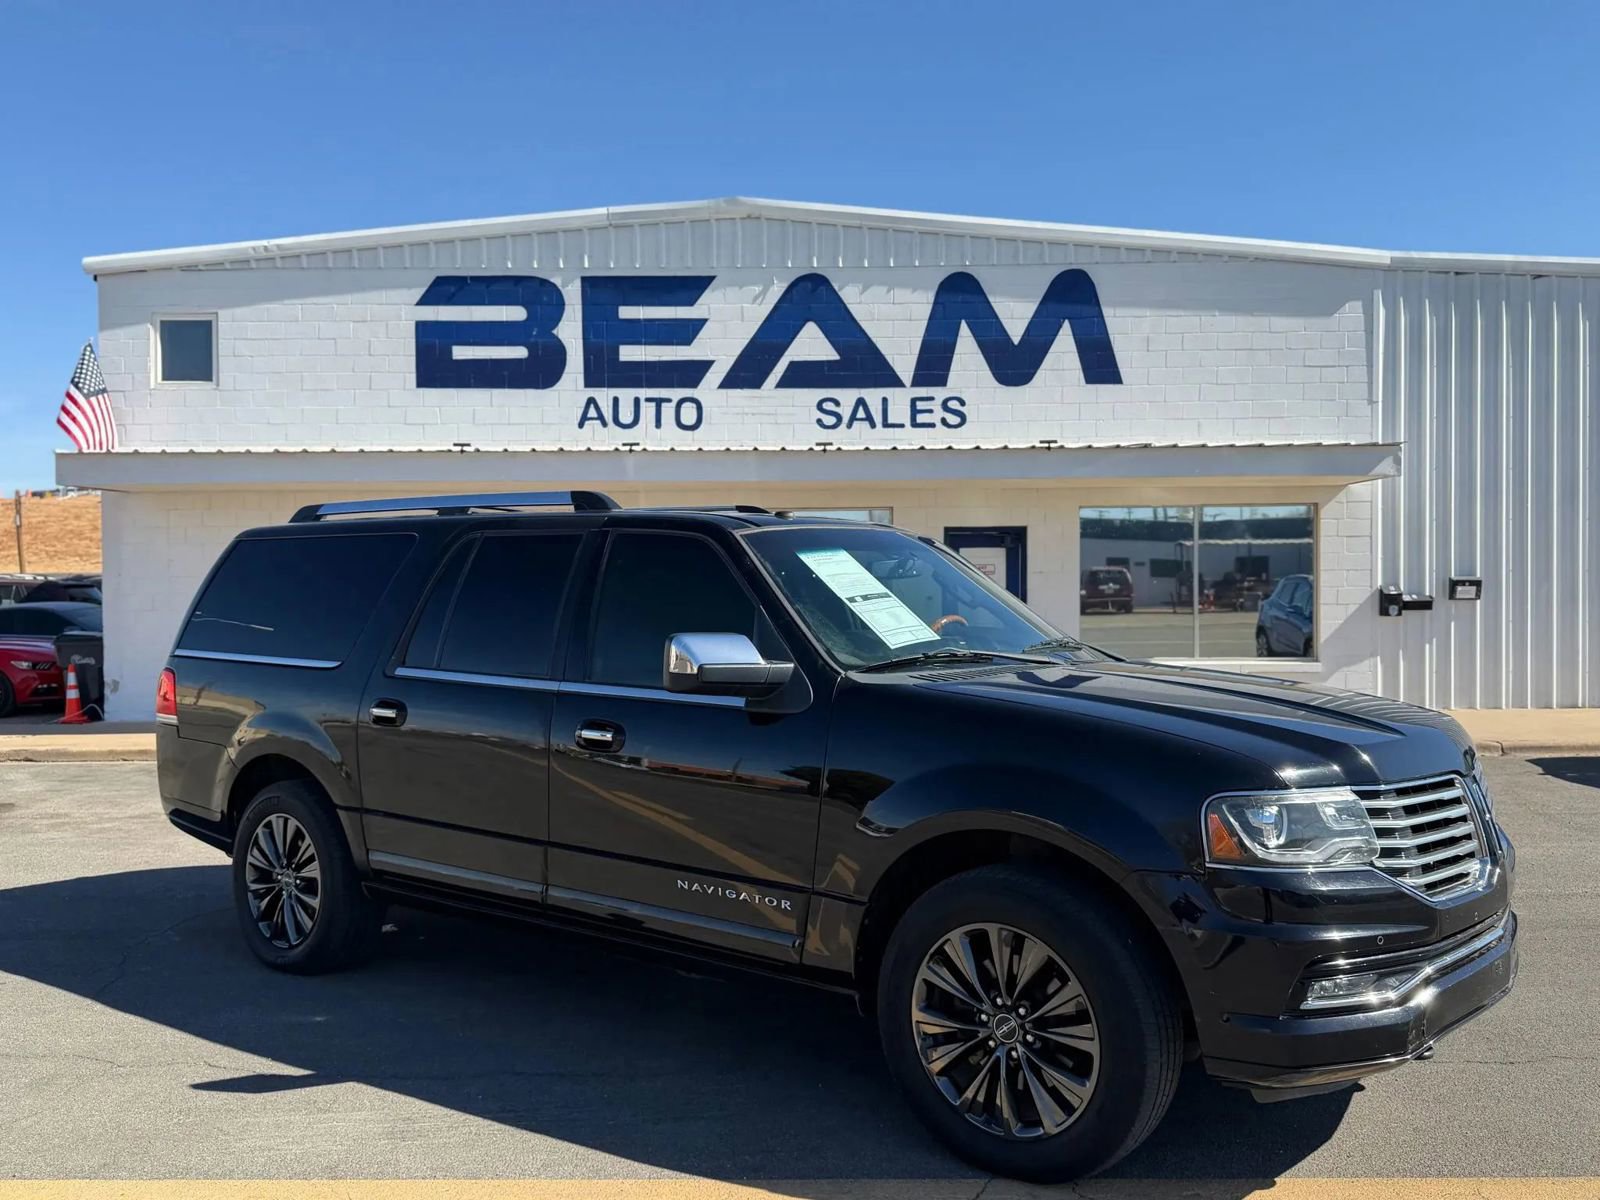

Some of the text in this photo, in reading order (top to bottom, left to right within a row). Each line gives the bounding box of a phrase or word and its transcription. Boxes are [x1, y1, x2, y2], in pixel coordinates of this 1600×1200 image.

[415, 269, 1122, 389] BEAM
[578, 396, 966, 431] AUTO SALES
[677, 879, 792, 910] NAVIGATOR
